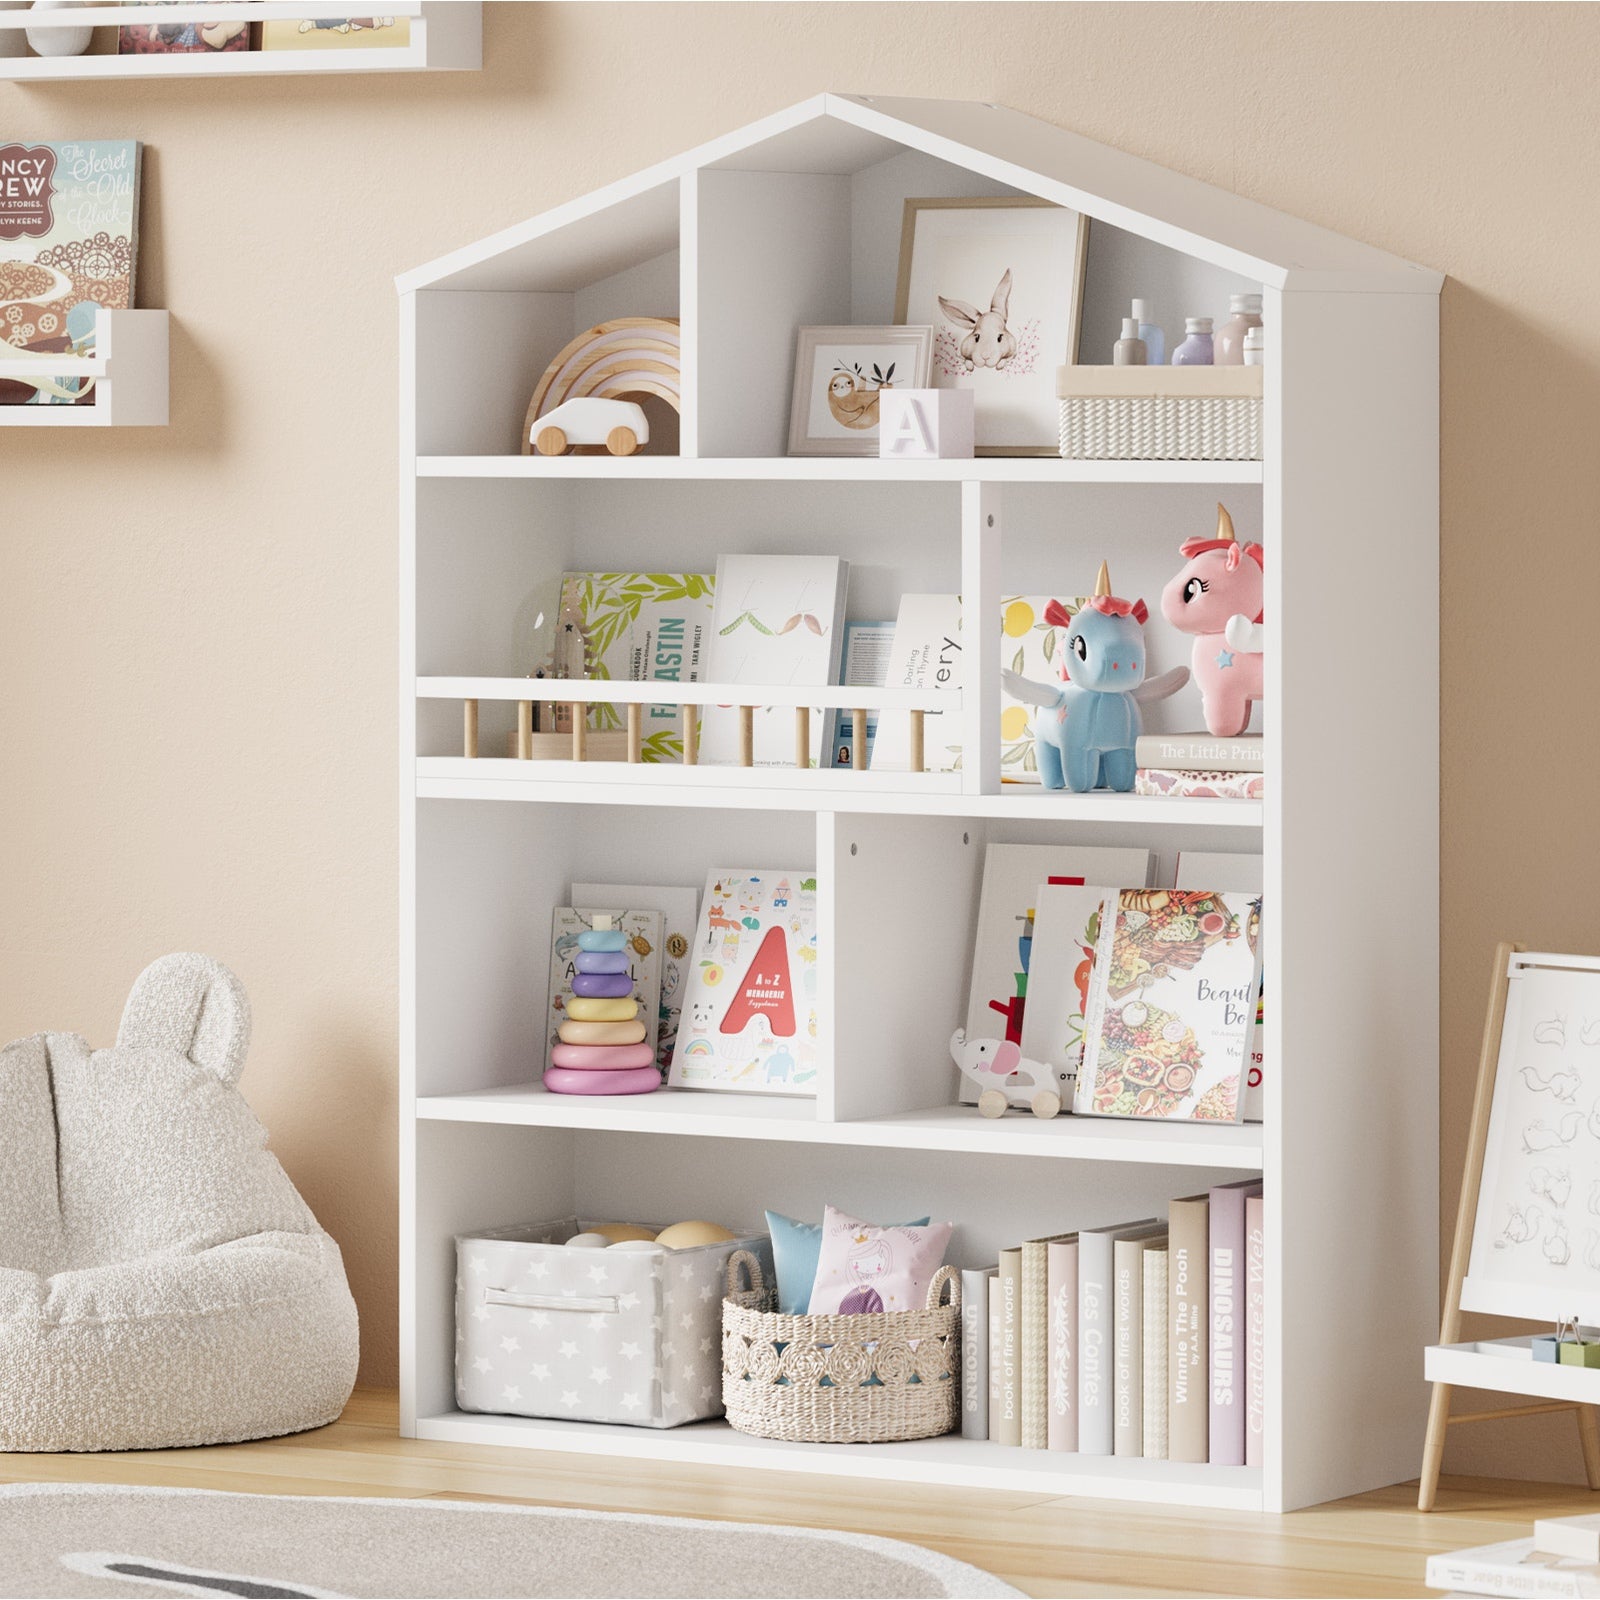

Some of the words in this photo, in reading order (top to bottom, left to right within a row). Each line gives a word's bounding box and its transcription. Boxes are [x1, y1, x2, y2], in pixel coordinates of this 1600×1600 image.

[1, 159, 47, 175] NCY
[61, 144, 85, 163] The
[67, 148, 128, 181] Secret
[87, 173, 130, 205] Old
[67, 200, 131, 234] Clock
[889, 397, 936, 452] A
[694, 625, 702, 649] WIGLEY
[651, 618, 685, 718] FASTIN
[692, 649, 700, 665] TARA
[904, 649, 920, 685] Darling
[917, 644, 930, 674] Thyme
[1160, 744, 1185, 758] The
[1190, 744, 1228, 760] Little
[746, 989, 785, 999] MENAGERIE
[755, 973, 763, 985] A
[773, 974, 781, 986] Z
[1198, 979, 1252, 1003] Beaut
[1176, 1249, 1188, 1296] Pooh
[1250, 1229, 1263, 1284] Web
[1003, 1277, 1013, 1323] words
[1085, 1281, 1103, 1320] Les
[1119, 1269, 1130, 1321] words
[1176, 1302, 1188, 1336] The
[1191, 1305, 1199, 1330] Milne
[1214, 1248, 1233, 1406] DINOSAURS
[965, 1304, 978, 1412] UNICORNS
[1003, 1328, 1013, 1357] first
[1119, 1328, 1130, 1357] first
[1003, 1360, 1013, 1377] of
[1085, 1329, 1103, 1406] Contes
[1119, 1362, 1130, 1380] of
[1176, 1341, 1188, 1404] Winnie
[1191, 1354, 1199, 1366] by
[1250, 1292, 1263, 1434] Charlotte's
[1003, 1382, 1013, 1420] book
[1119, 1386, 1130, 1427] book
